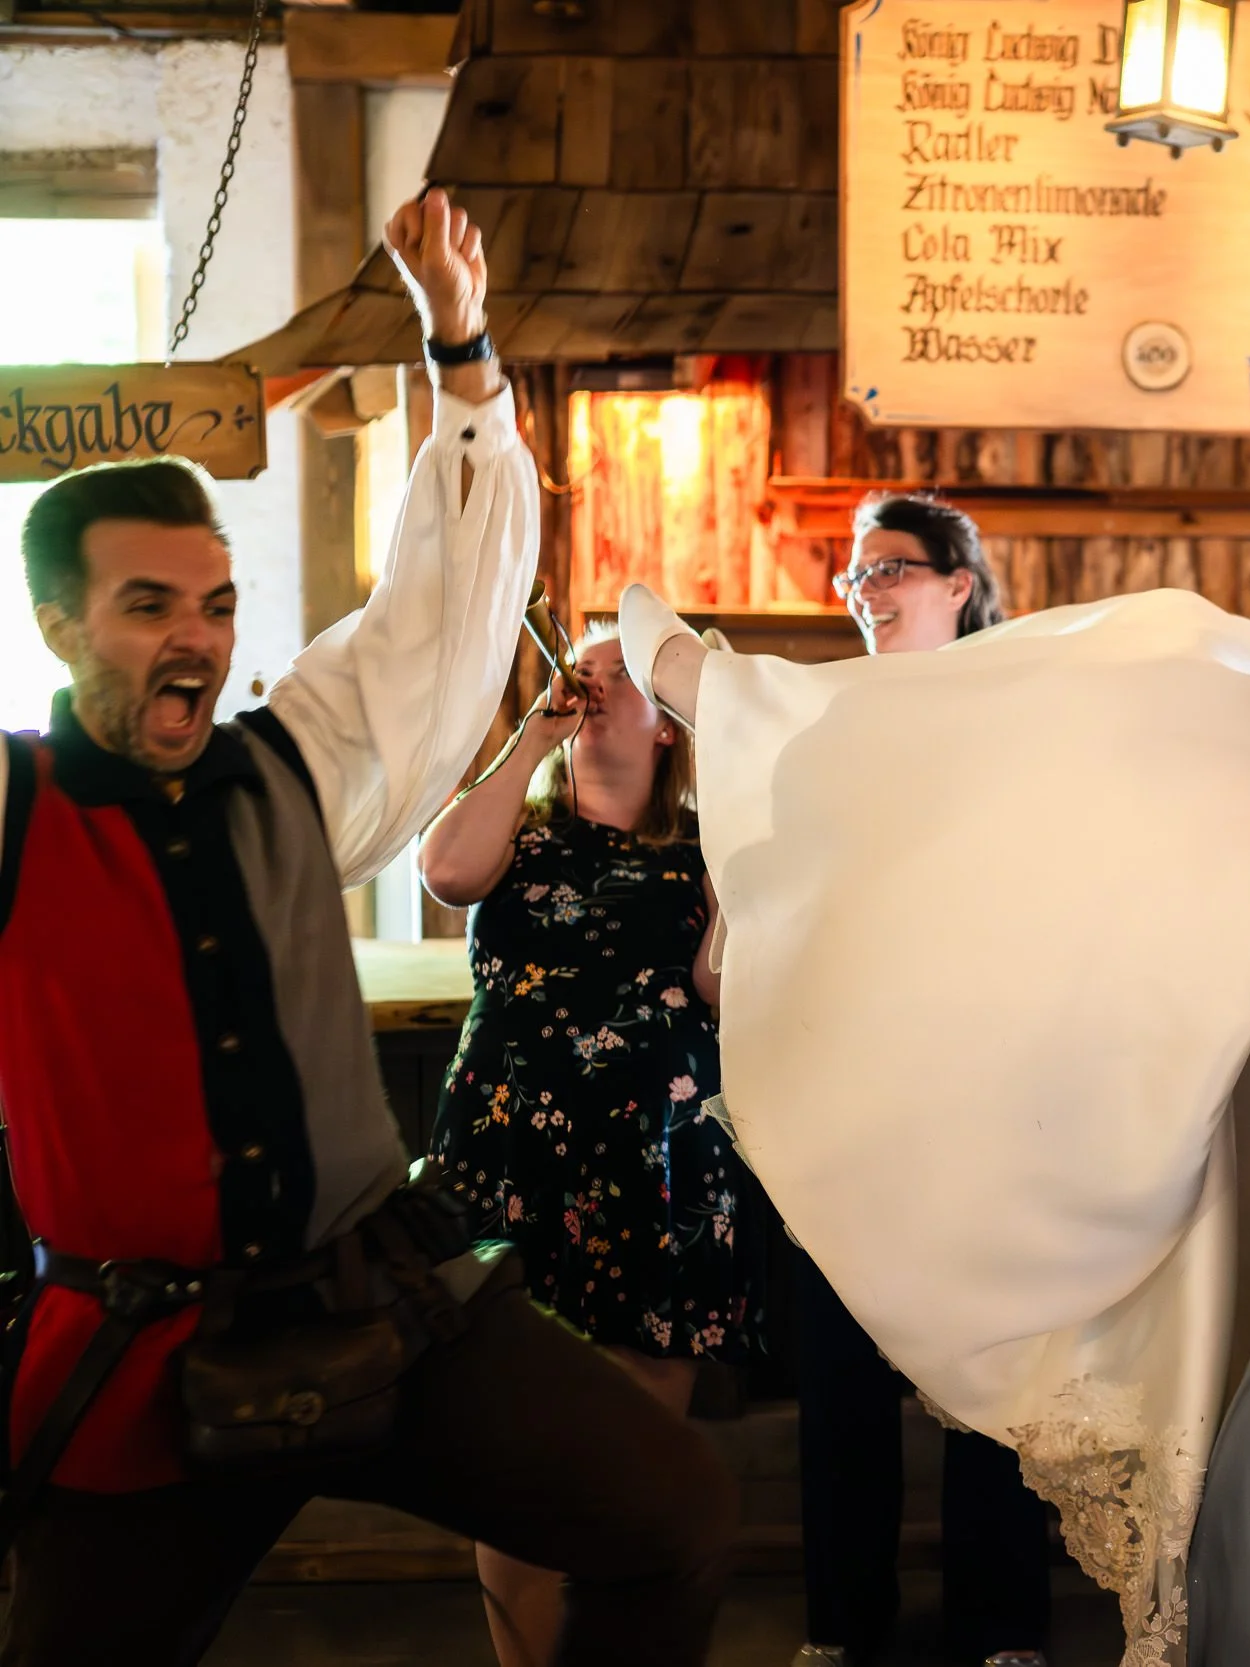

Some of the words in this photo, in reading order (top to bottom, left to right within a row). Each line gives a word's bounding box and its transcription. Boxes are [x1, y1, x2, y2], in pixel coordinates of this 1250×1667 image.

[897, 18, 970, 67] König
[982, 20, 1078, 69] Ludwig
[895, 69, 970, 119] König
[983, 69, 1074, 121] Ludwig
[900, 120, 1020, 165] Radler
[902, 222, 971, 262] Cola
[988, 223, 1063, 264] Mix
[899, 272, 1089, 323] Apfelschorle
[901, 326, 1037, 363] Wasser
